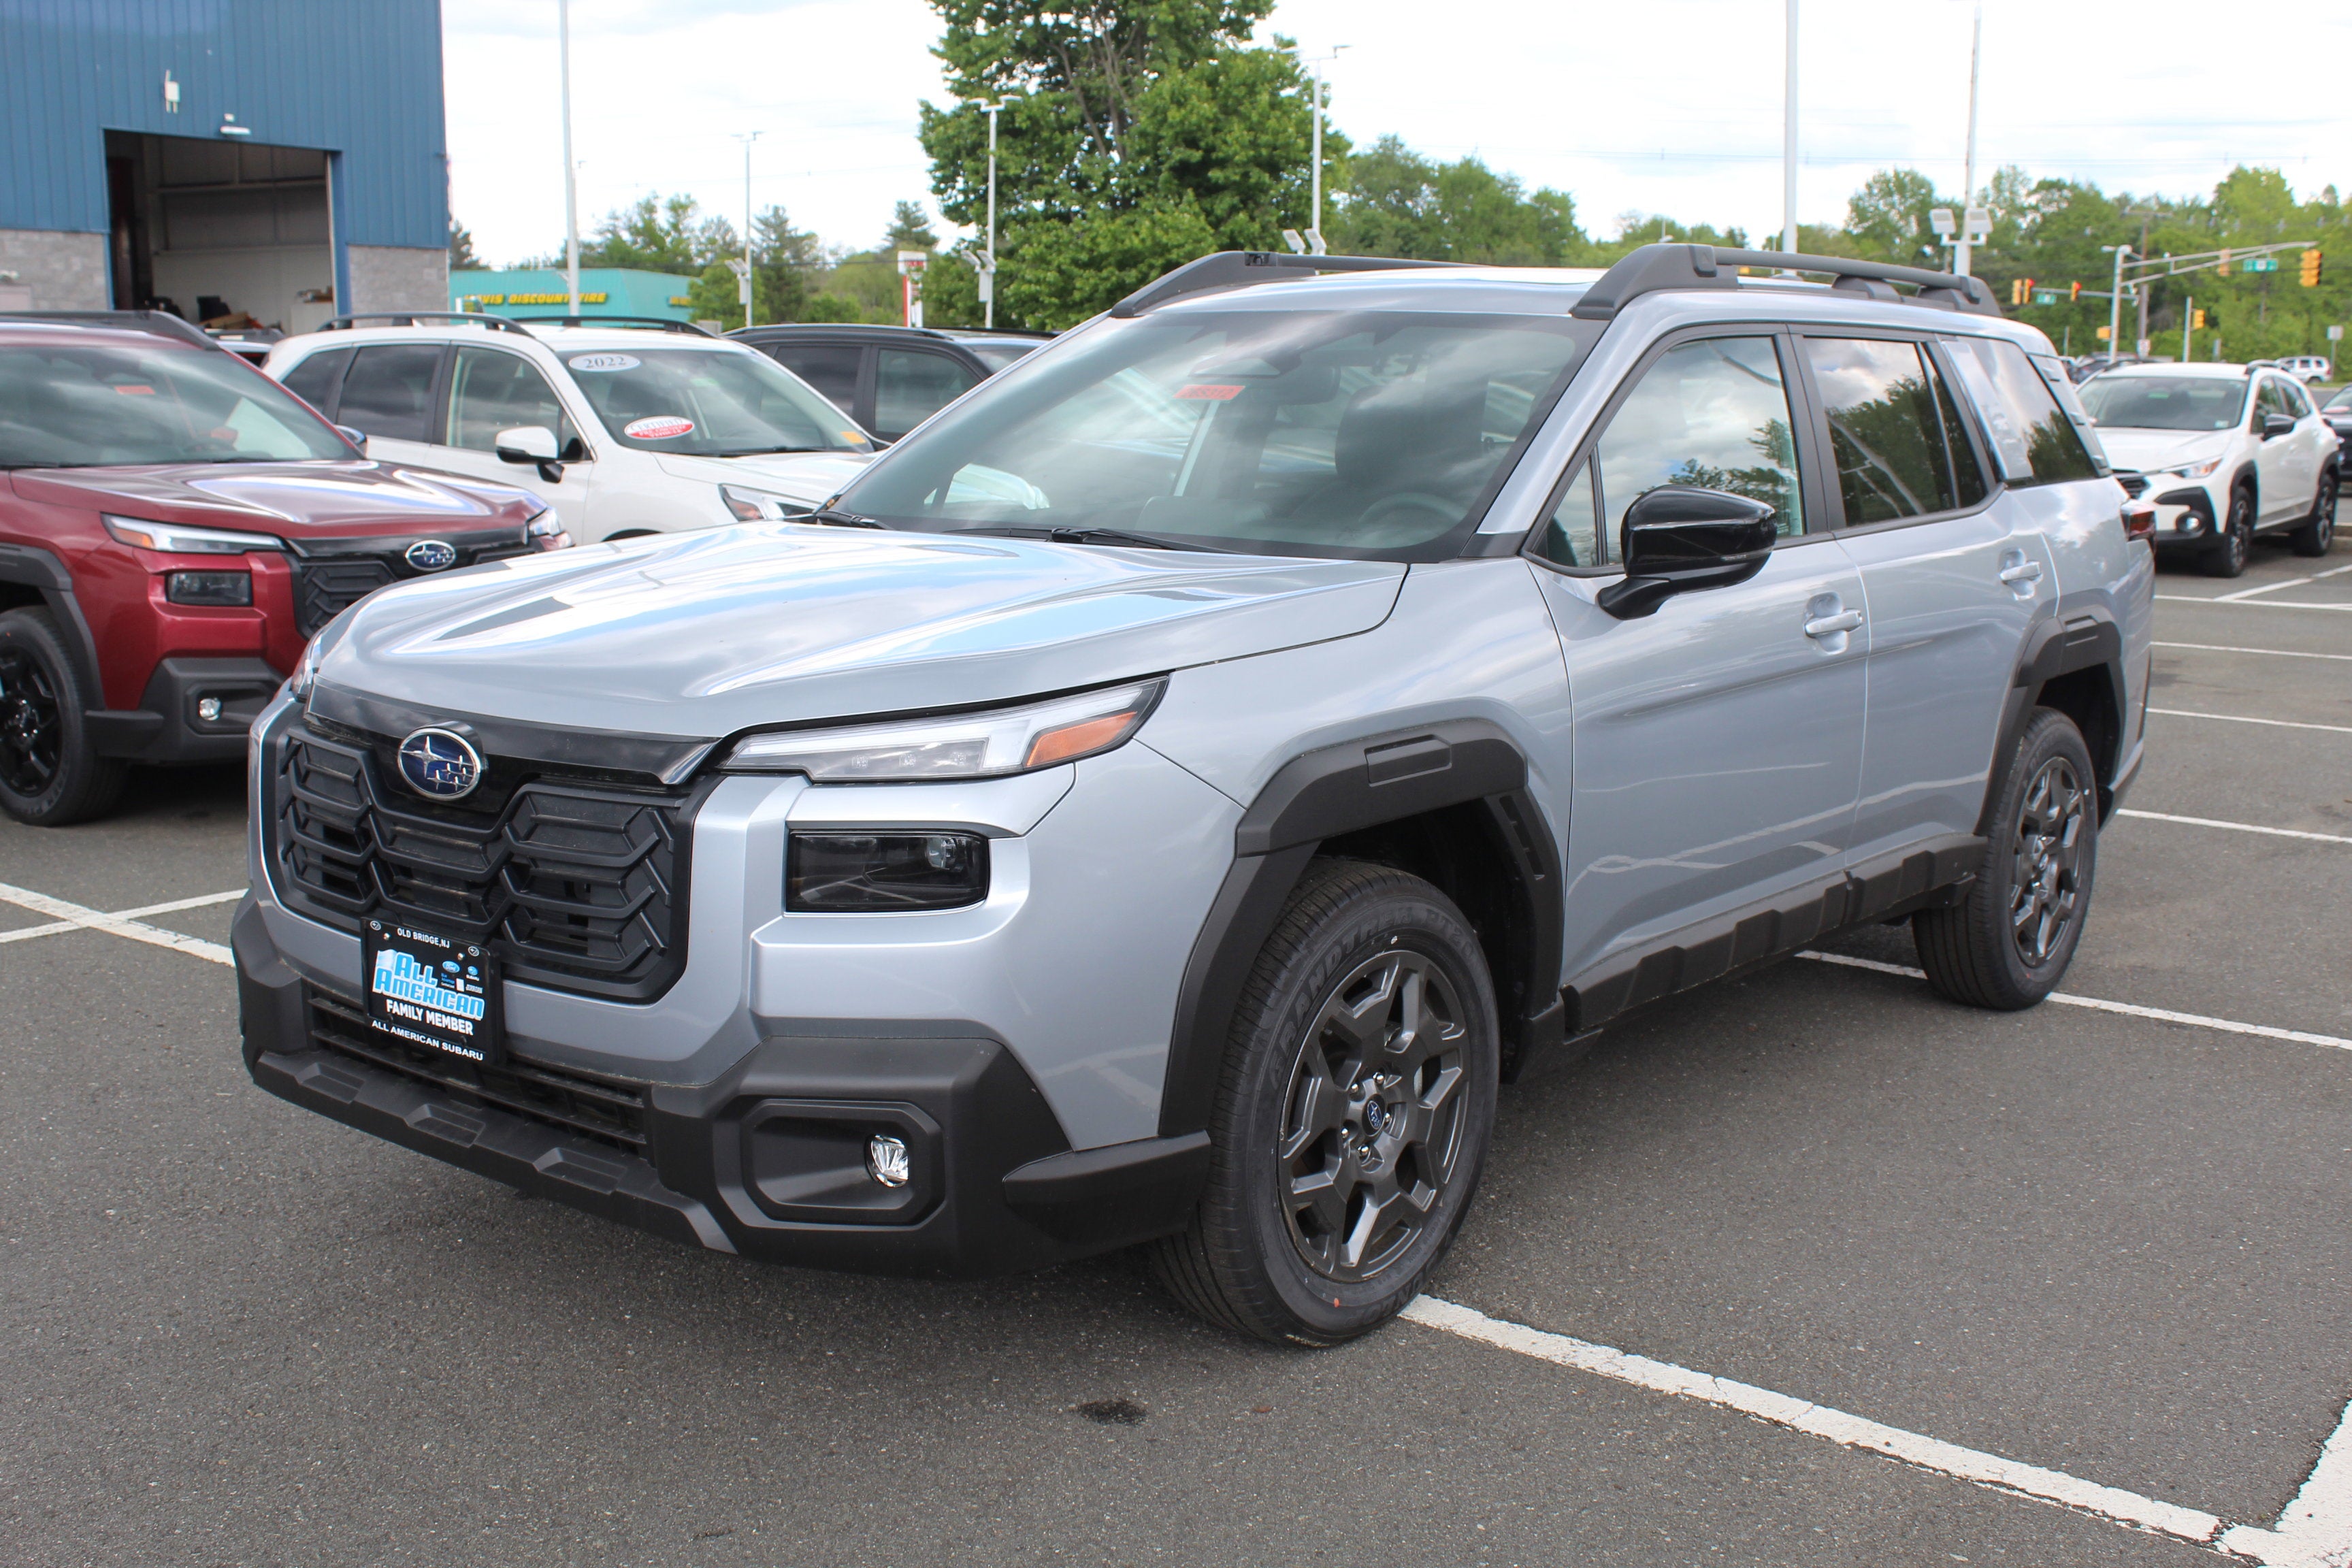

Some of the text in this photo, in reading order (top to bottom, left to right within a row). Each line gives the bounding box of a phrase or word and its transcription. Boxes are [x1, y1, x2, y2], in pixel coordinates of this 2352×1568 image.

[583, 356, 626, 368] 2022
[397, 927, 411, 938] OLD
[394, 951, 438, 987] ALL
[372, 966, 485, 1021] AMERICAN
[386, 999, 474, 1035] FAMILY MEMBER
[372, 1020, 483, 1061] ALL AMERICAN SUBARU
